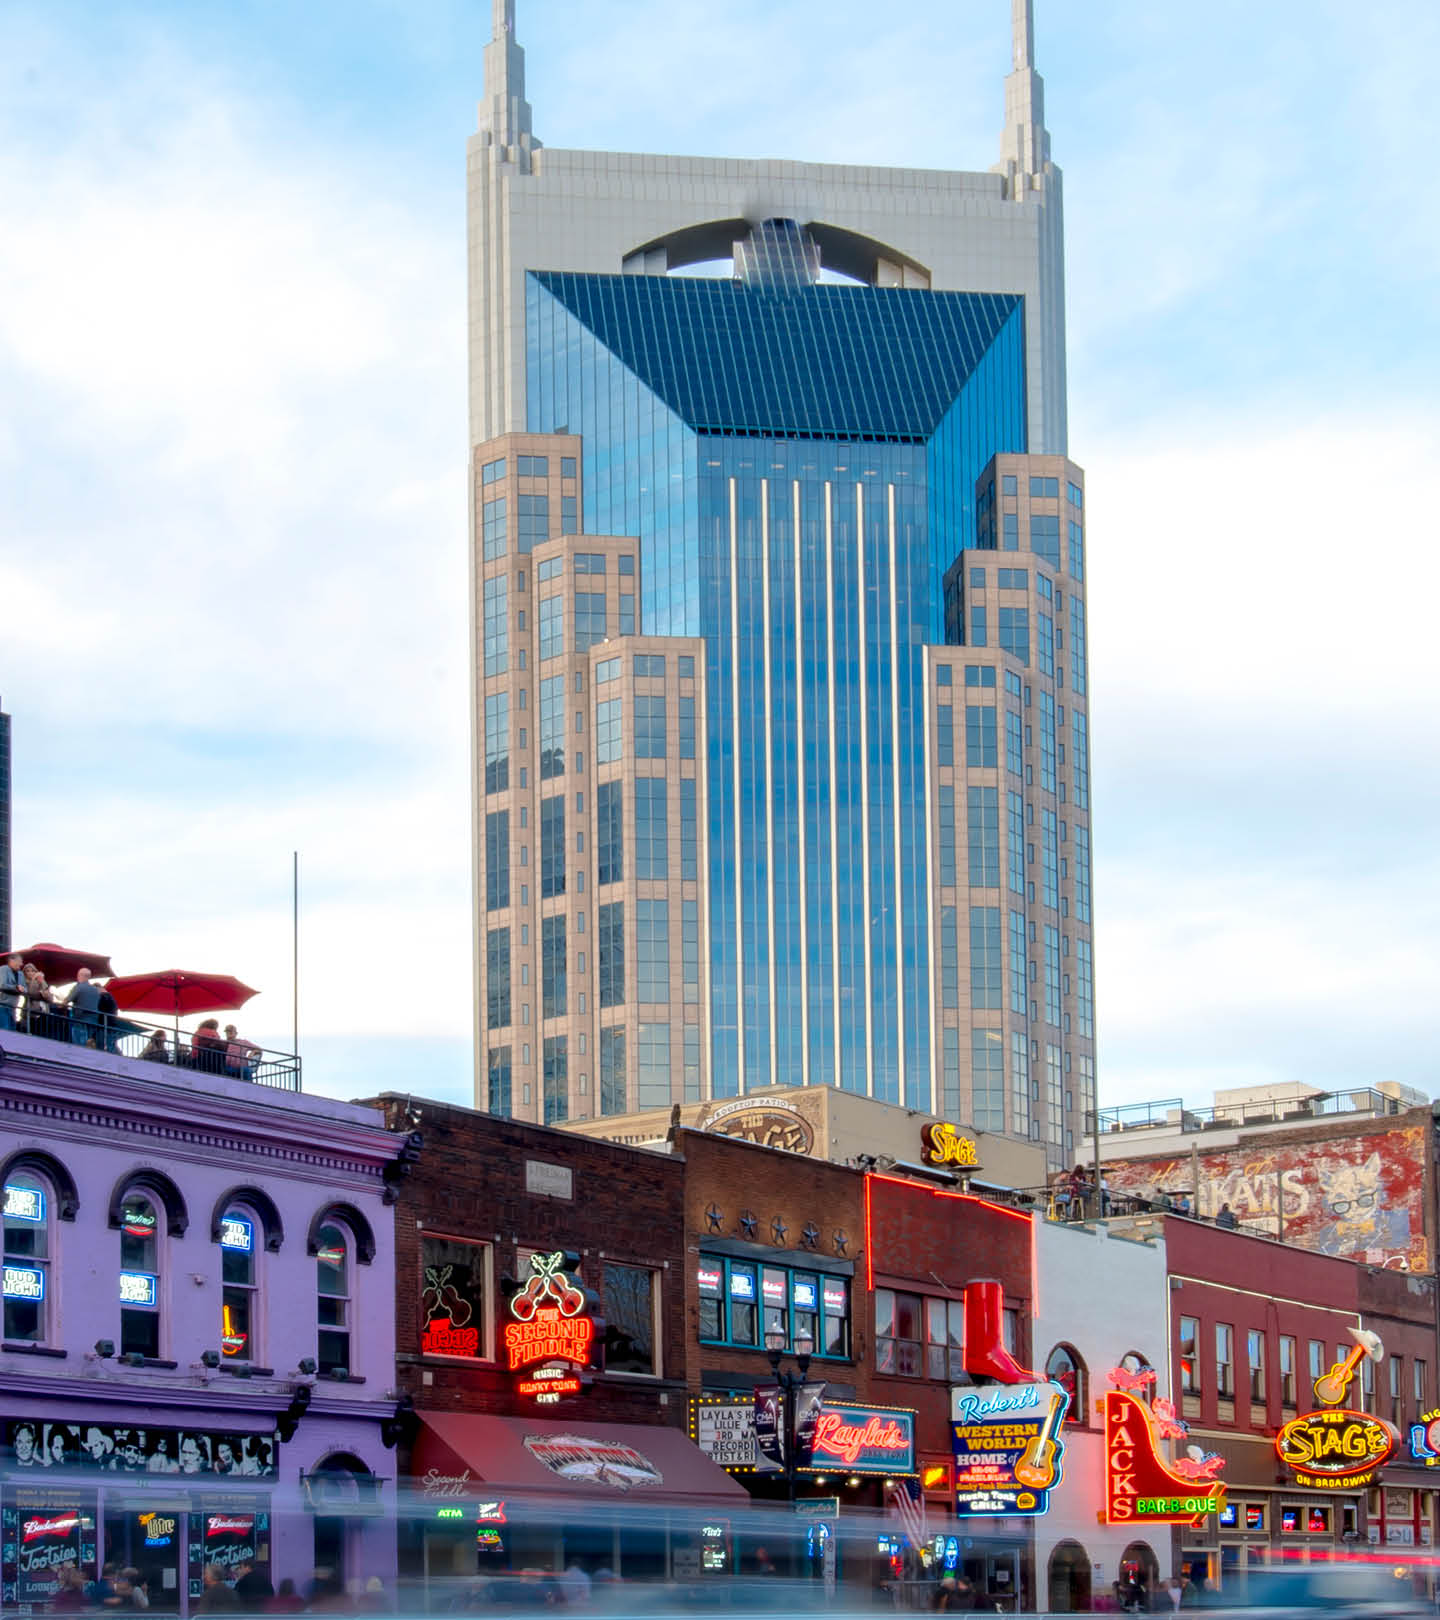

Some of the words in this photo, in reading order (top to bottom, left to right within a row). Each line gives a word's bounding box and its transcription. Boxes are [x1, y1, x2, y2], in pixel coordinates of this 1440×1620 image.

[759, 1098, 786, 1107] PATIO
[931, 1124, 978, 1165] STAGE
[5, 1269, 36, 1284] BUD
[536, 1308, 560, 1321] THE
[506, 1318, 591, 1347] SECOND
[509, 1339, 587, 1369] FIDDLE
[533, 1369, 564, 1380] MUSIC
[520, 1383, 550, 1392] HONKY
[959, 1386, 1040, 1424] Robert's
[701, 1411, 743, 1420] LAYLA'S
[1322, 1413, 1345, 1423] THE
[714, 1421, 741, 1430] LILLIE
[955, 1424, 1039, 1439] WESTERN
[715, 1432, 734, 1441] 3RD
[813, 1414, 910, 1463] Layla's
[1283, 1420, 1387, 1464] STAGE
[713, 1442, 754, 1451] RECORDI
[966, 1438, 1028, 1451] WORLD
[957, 1454, 1007, 1466] HOME
[1008, 1452, 1019, 1467] of
[1110, 1402, 1139, 1519] JACKS
[423, 1468, 470, 1485] Second
[1296, 1474, 1310, 1486] ON
[1315, 1474, 1372, 1487] BROADWAY
[438, 1508, 463, 1518] ATM
[1137, 1498, 1216, 1513] BAR-B-QUE
[21, 1544, 77, 1572] Tootsies
[204, 1544, 254, 1568] Tootsies
